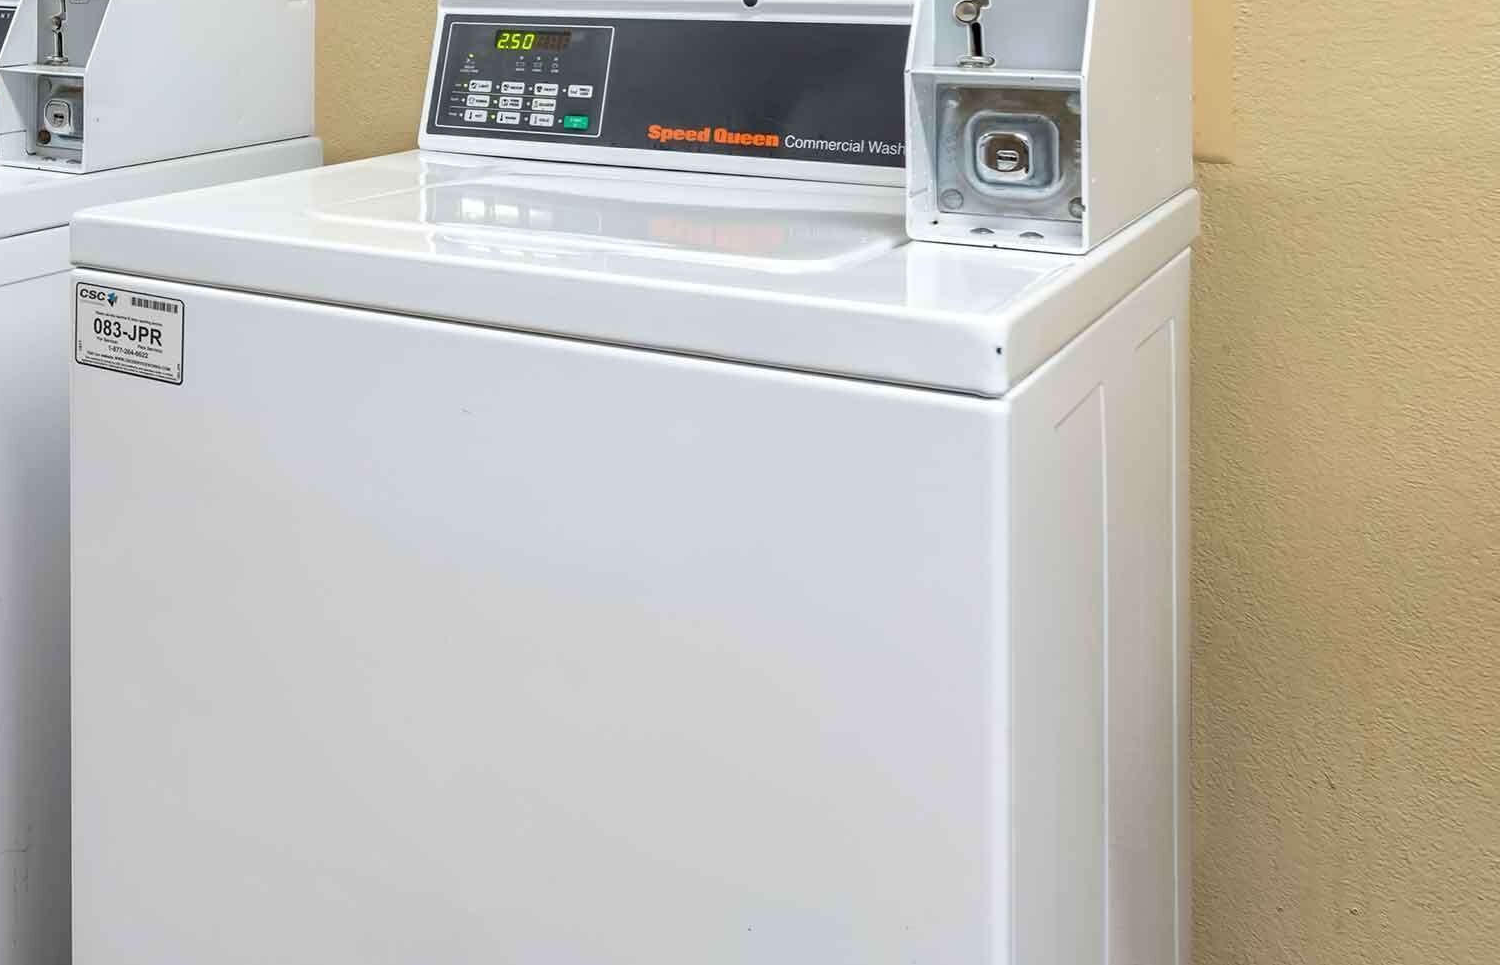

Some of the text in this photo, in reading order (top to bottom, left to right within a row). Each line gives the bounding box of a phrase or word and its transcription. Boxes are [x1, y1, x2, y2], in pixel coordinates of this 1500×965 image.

[497, 33, 534, 50] 2.50
[648, 124, 779, 147] Speed Queen
[784, 135, 864, 153] Commercial
[79, 288, 106, 301] CSC
[93, 317, 163, 347] 083-JPR
